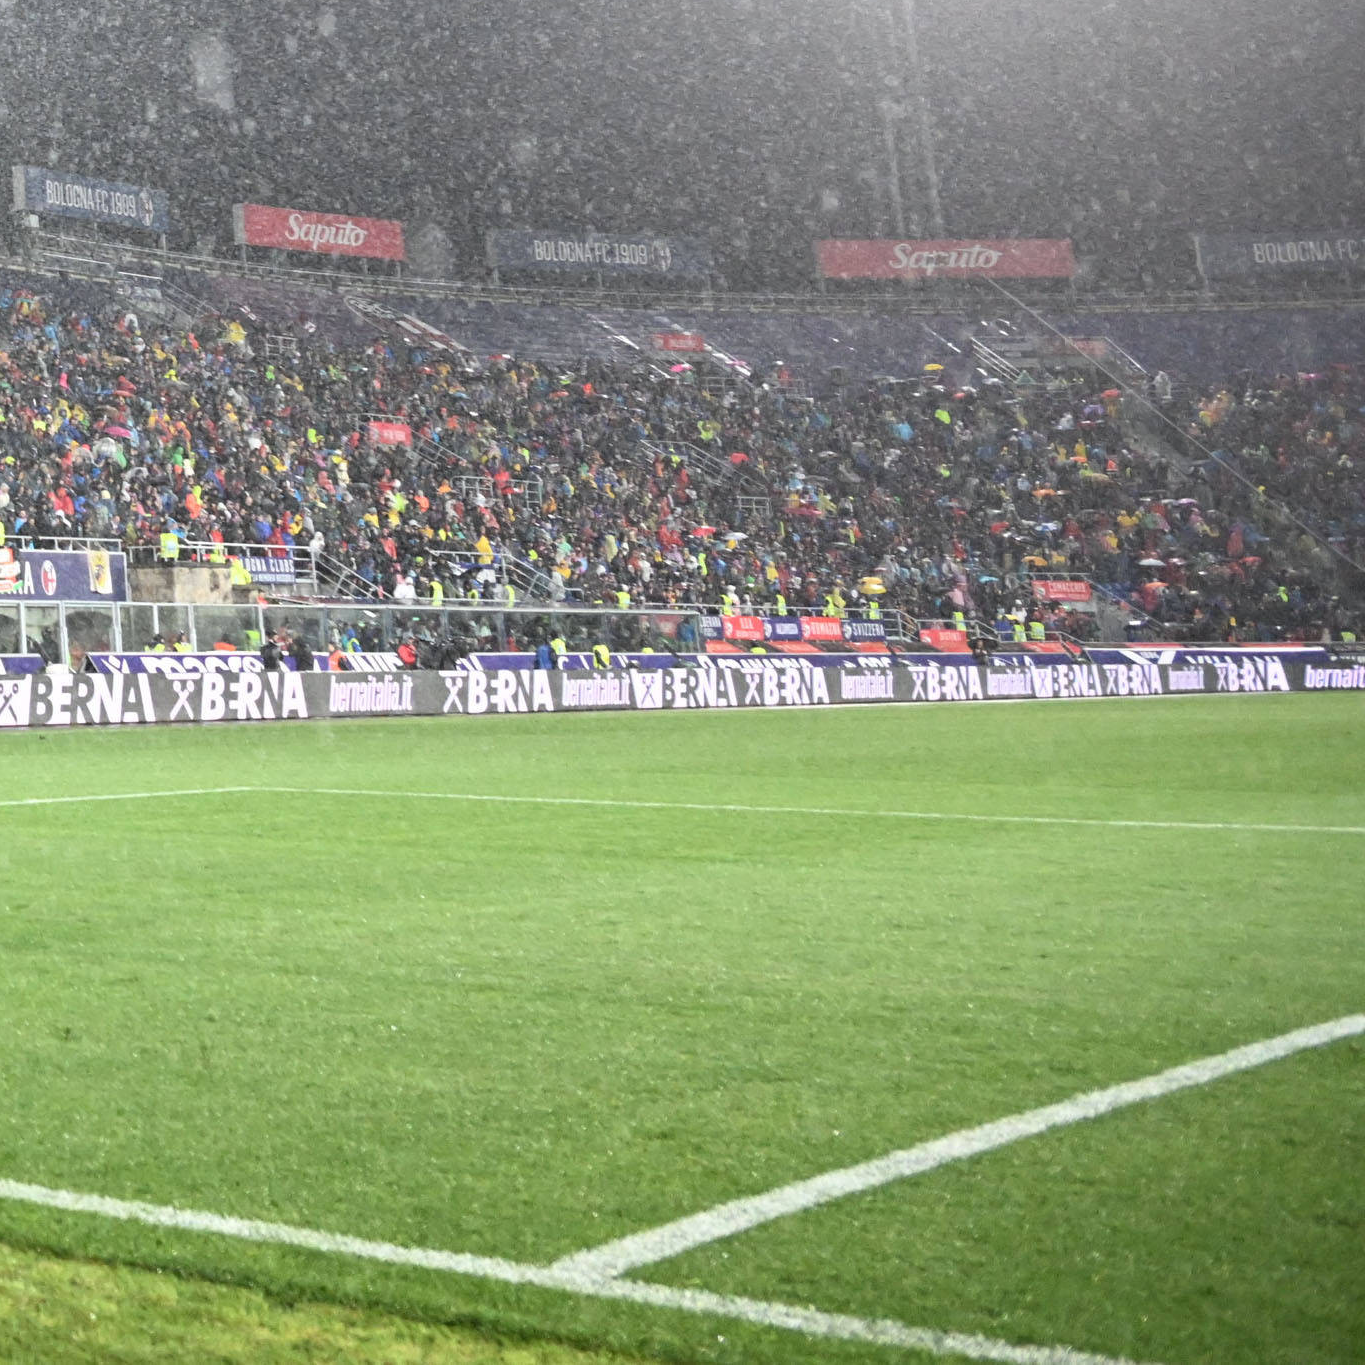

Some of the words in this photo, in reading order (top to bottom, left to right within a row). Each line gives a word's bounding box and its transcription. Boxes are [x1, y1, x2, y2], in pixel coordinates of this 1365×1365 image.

[46, 179, 95, 211] BOLOGNA
[94, 189, 109, 213] FC
[110, 191, 137, 217] 1909
[284, 213, 368, 251] Saputo
[1252, 239, 1335, 264] BOLOGNA
[1335, 238, 1360, 261] FC
[533, 239, 593, 263] BOLOGNA
[594, 241, 612, 264] FC
[613, 243, 648, 265] 1909
[30, 672, 148, 726] BERNA
[200, 670, 310, 721] BERNA
[328, 674, 413, 713] bernaitalia.it
[466, 669, 556, 714] BERNA
[762, 667, 830, 706] BERNA
[927, 665, 984, 701] BERNA
[1118, 664, 1163, 695] BERNA
[1226, 662, 1290, 692] BERNA
